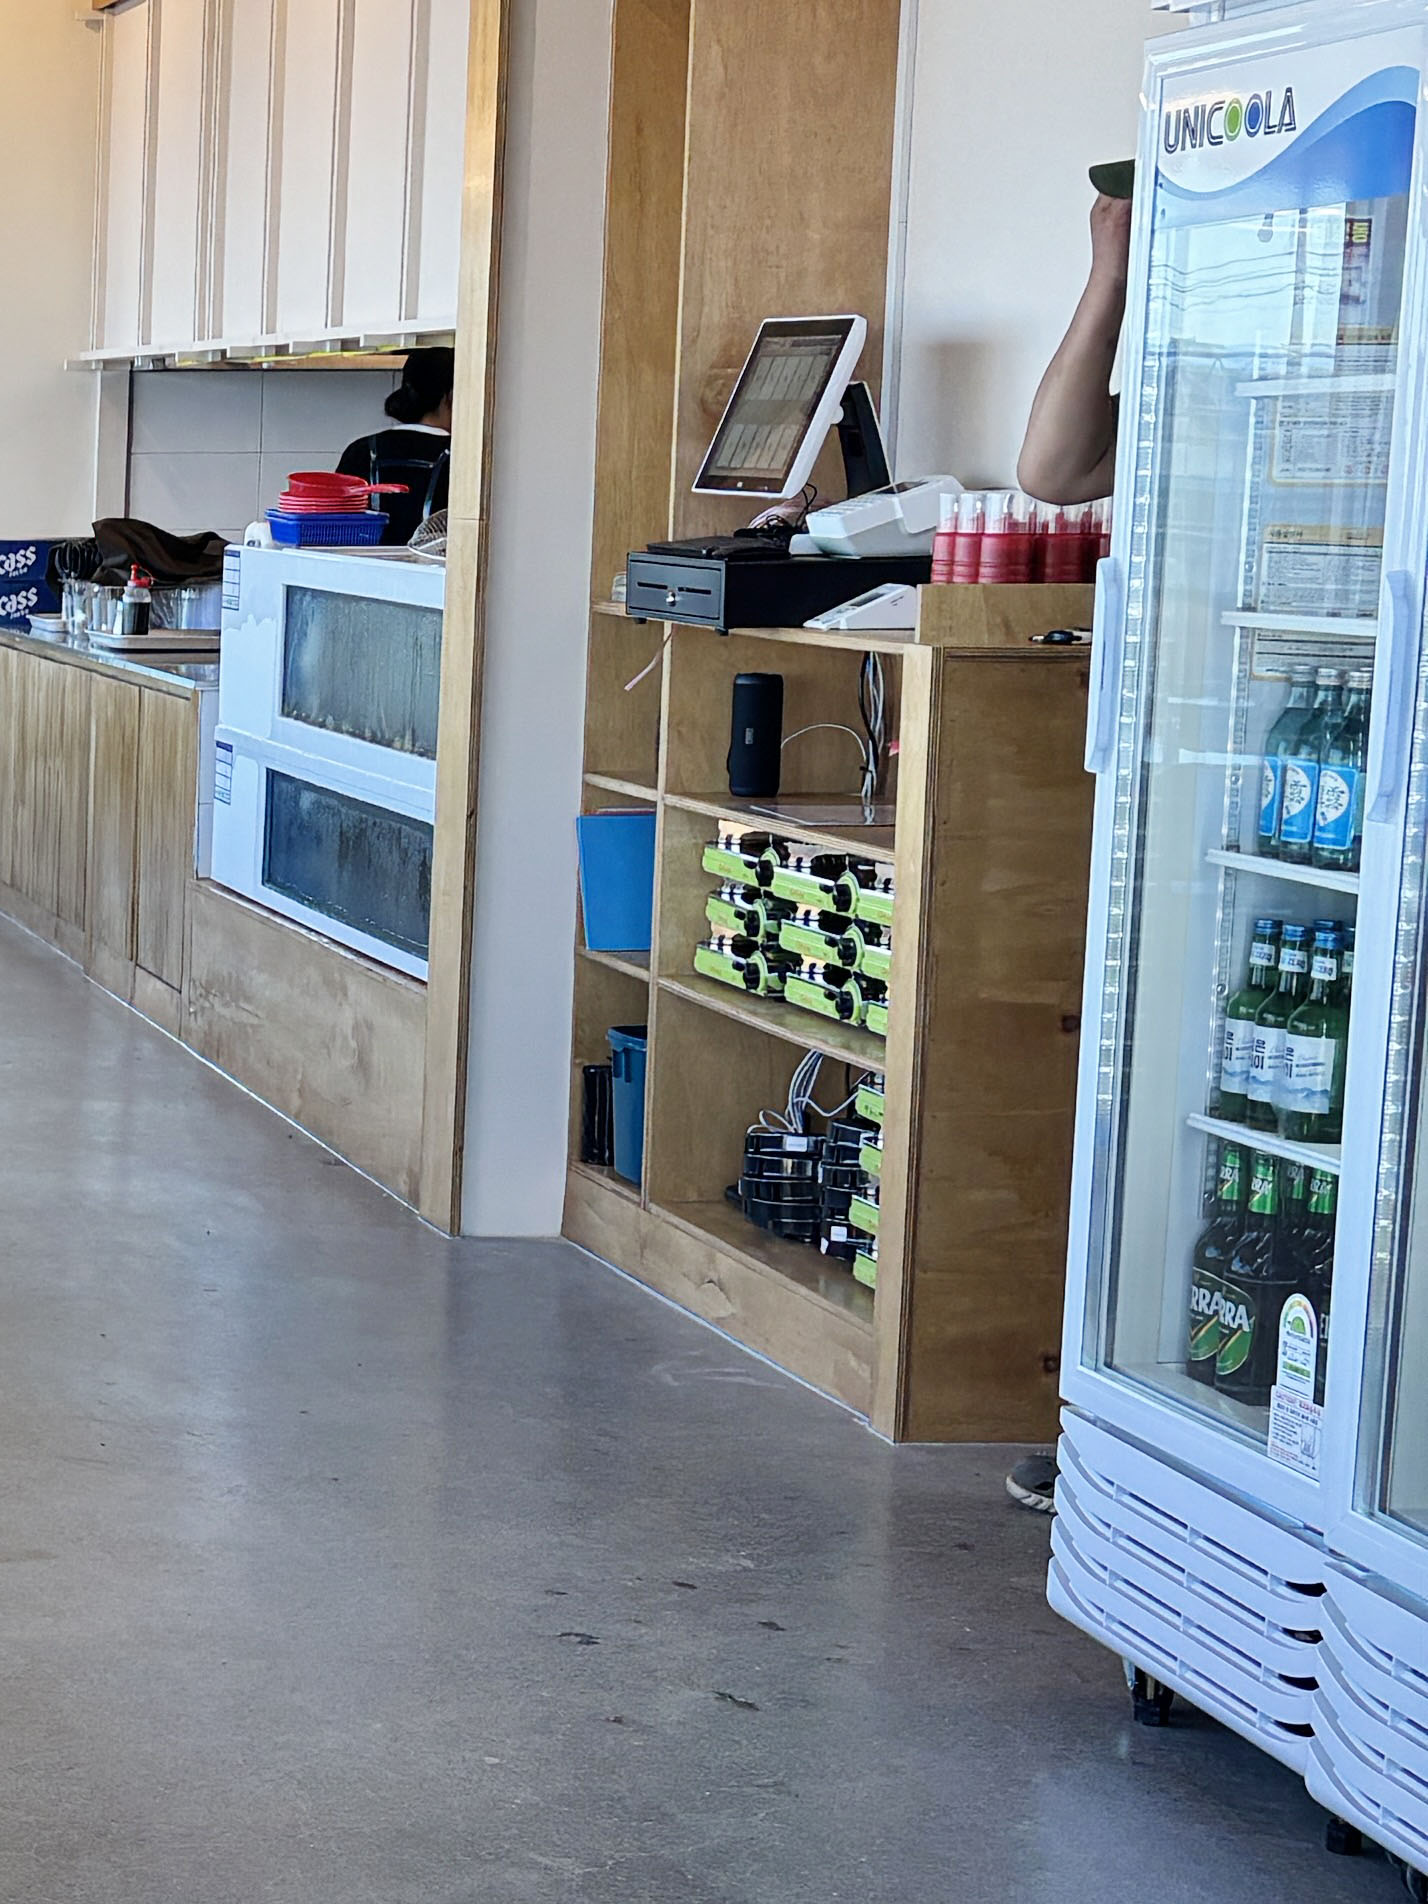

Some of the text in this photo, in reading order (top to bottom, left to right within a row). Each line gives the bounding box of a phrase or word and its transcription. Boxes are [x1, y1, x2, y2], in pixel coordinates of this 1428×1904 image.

[1163, 87, 1297, 155] UNICOOLA
[1190, 1285, 1222, 1315] RRA
[1218, 1298, 1250, 1332] RRA
